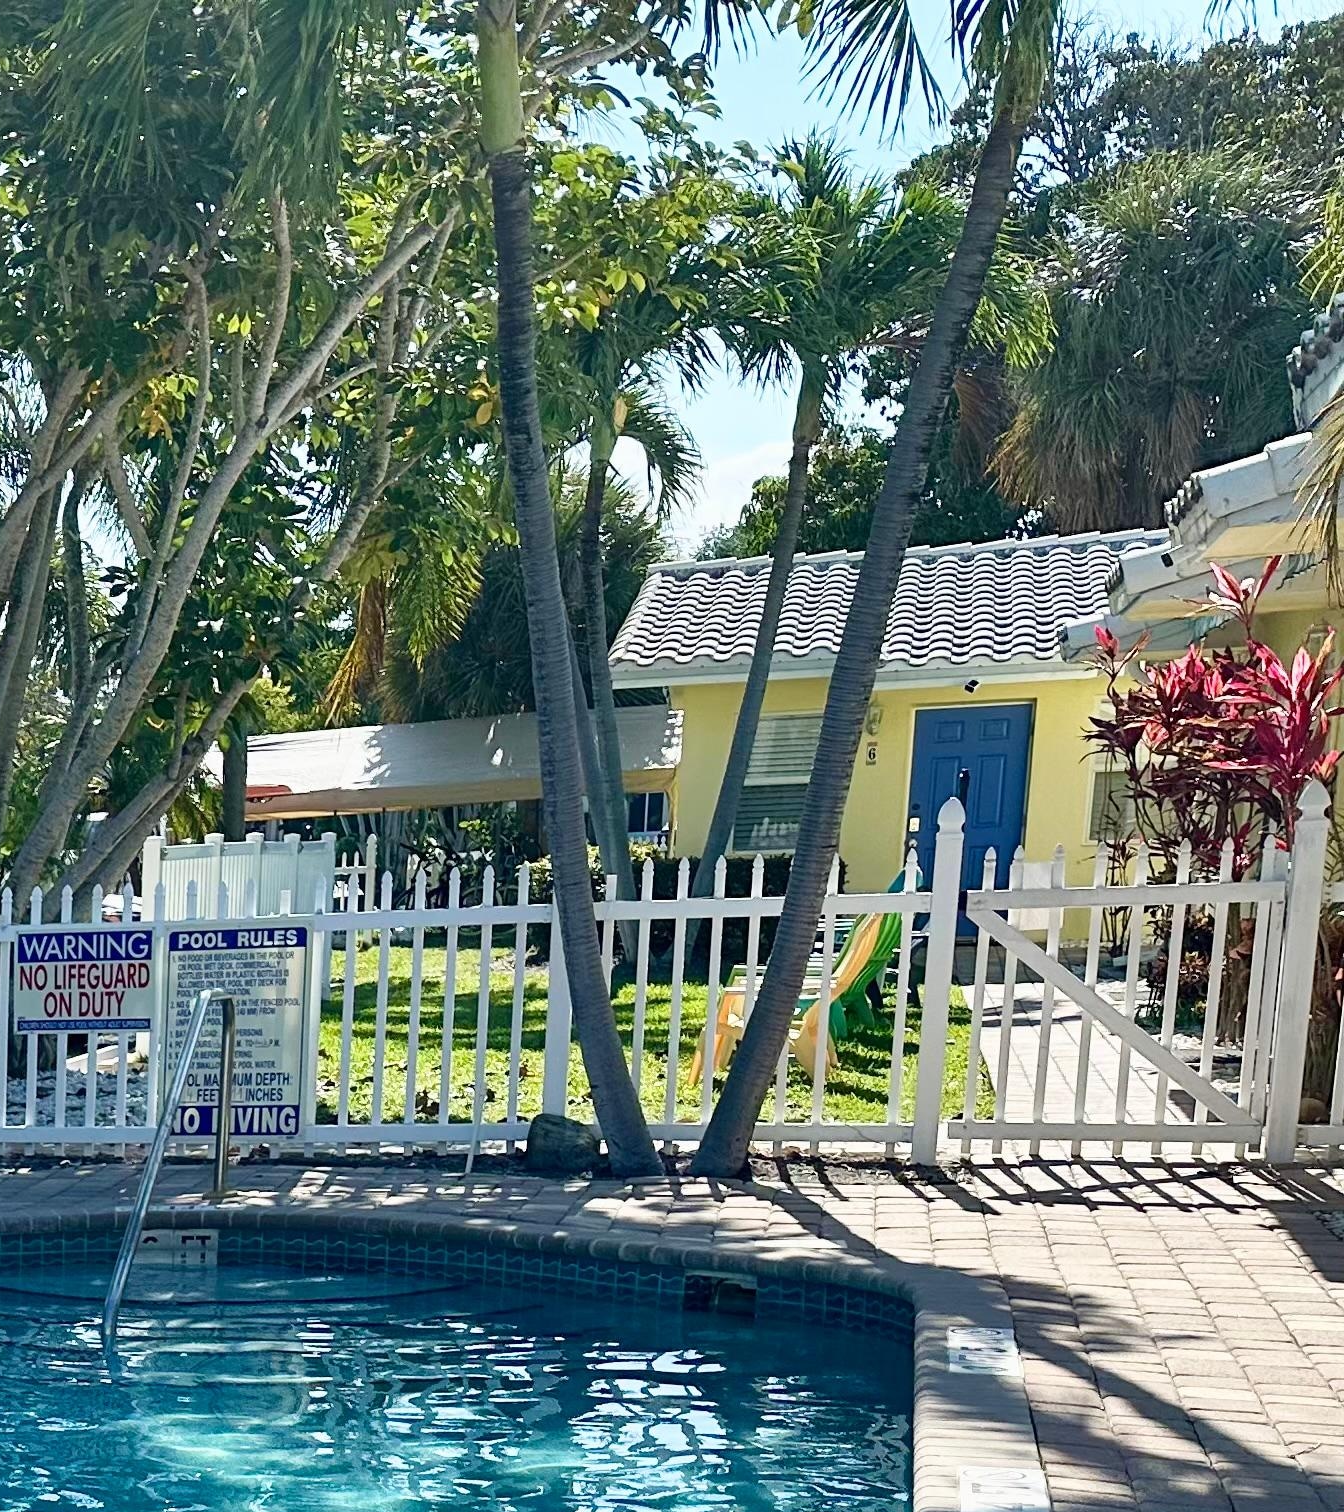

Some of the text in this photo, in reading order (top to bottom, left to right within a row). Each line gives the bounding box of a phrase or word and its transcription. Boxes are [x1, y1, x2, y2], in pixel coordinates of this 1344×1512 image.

[868, 747, 876, 760] 6
[22, 933, 148, 960] WARNING
[178, 930, 298, 949] POOL RULES
[20, 963, 150, 991] NO LIFEGUARD
[44, 991, 125, 1018] ON DUTY
[204, 1073, 252, 1087] MAMUM
[255, 1072, 293, 1086] DEPTH:
[245, 1088, 283, 1102] INCHES
[212, 1107, 296, 1133] IVING
